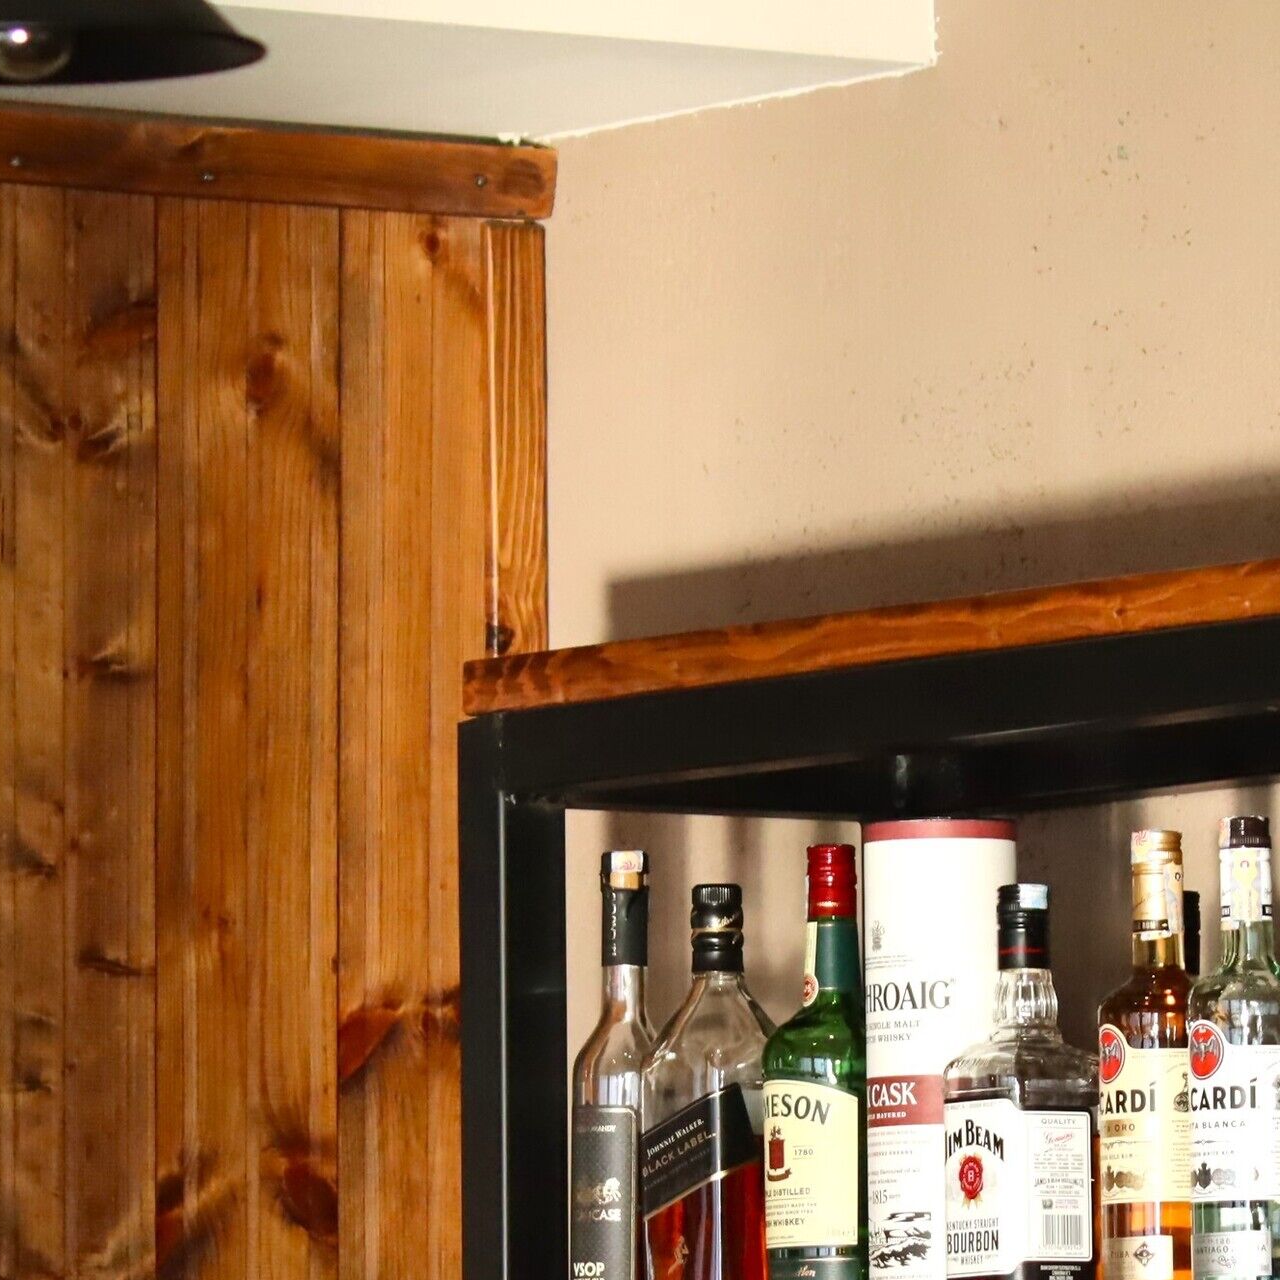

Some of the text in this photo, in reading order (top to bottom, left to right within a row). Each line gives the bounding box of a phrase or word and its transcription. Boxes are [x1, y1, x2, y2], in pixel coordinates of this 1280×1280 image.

[894, 1019, 920, 1029] MALT
[877, 1032, 912, 1043] WHISKY
[872, 1082, 917, 1105] CASK
[1114, 1123, 1136, 1132] ORO
[1202, 1121, 1246, 1129] BLANCA
[945, 1119, 1005, 1161] JIM BEAM
[646, 1135, 676, 1159] JOHNNIE
[794, 1148, 814, 1156] 1780
[642, 1151, 676, 1178] BLACK
[772, 1187, 811, 1197] DISTILLED
[773, 1217, 805, 1227] WHISKEY
[974, 1217, 999, 1228] STRAIGHT
[946, 1229, 999, 1254] BOURBON
[960, 1255, 984, 1265] WHISKEY
[573, 1262, 605, 1277] VSOP
